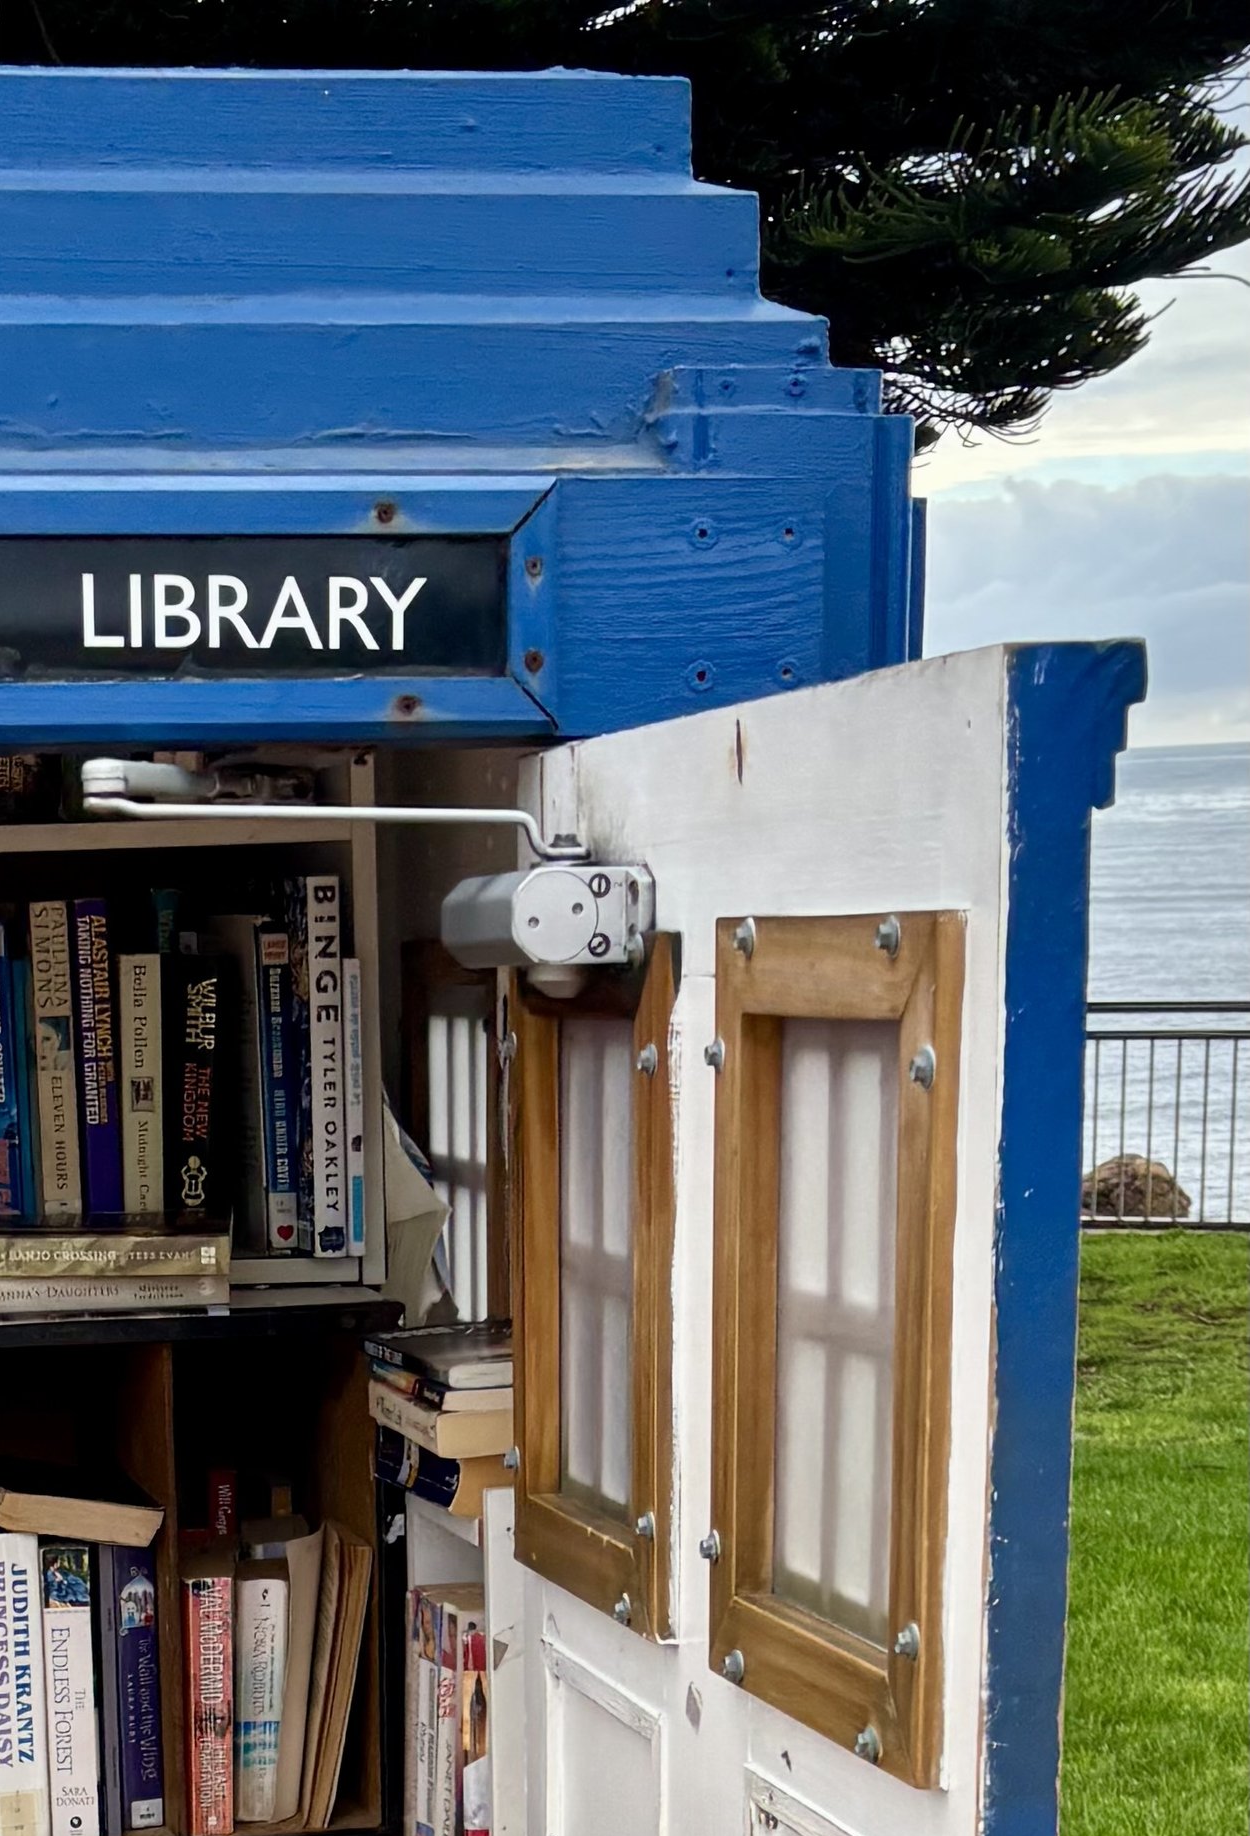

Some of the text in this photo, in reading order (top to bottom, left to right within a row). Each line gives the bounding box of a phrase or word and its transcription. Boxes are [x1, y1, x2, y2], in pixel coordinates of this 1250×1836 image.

[81, 573, 426, 650] LIBRARY
[34, 905, 49, 1009] SIMONS
[90, 914, 113, 1057] ALASTAIR LYNCH
[313, 885, 339, 1024] BINGE
[81, 1031, 96, 1060] FOR
[132, 965, 147, 1068] Bella Pollen
[184, 983, 202, 1052] SMITH
[199, 977, 218, 1050] WILBUR
[51, 1075, 68, 1190] ELEVEN HOURS
[83, 1061, 99, 1126] GRANTED
[181, 1062, 198, 1143] KINGDOM
[197, 1066, 213, 1143] THE NEW
[321, 1037, 340, 1212] TYLER OAKLEY
[54, 1249, 117, 1262] CROSSING
[11, 1564, 35, 1764] JUDITH KRANTZ
[198, 1586, 224, 1704] VAL McDERMID
[50, 1627, 74, 1776] ENDLESS FOREST
[74, 1688, 85, 1710] THE
[62, 1786, 88, 1797] SARA
